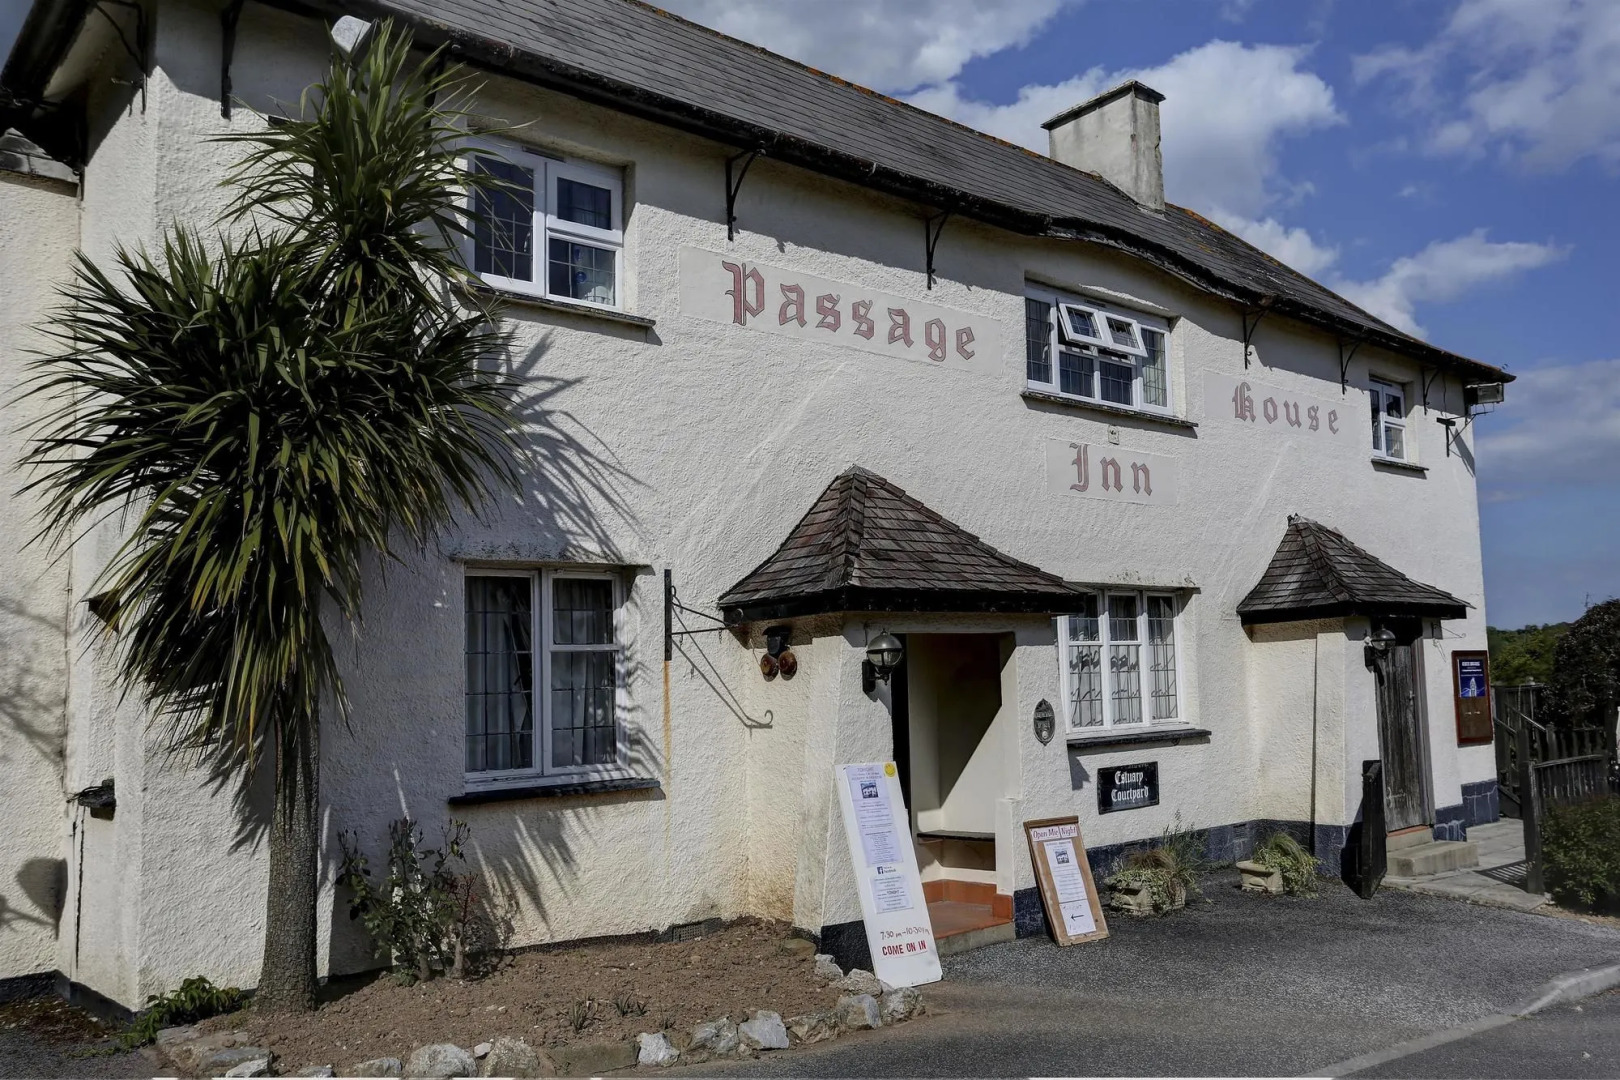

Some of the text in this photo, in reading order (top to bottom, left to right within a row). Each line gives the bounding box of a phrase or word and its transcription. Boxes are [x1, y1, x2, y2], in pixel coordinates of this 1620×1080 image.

[722, 260, 975, 362] Passage
[1069, 443, 1153, 496] Inn
[1111, 785, 1149, 802] Courtyard
[1033, 830, 1048, 840] Open
[1060, 826, 1076, 836] Night
[882, 939, 927, 956] COME ON IN
